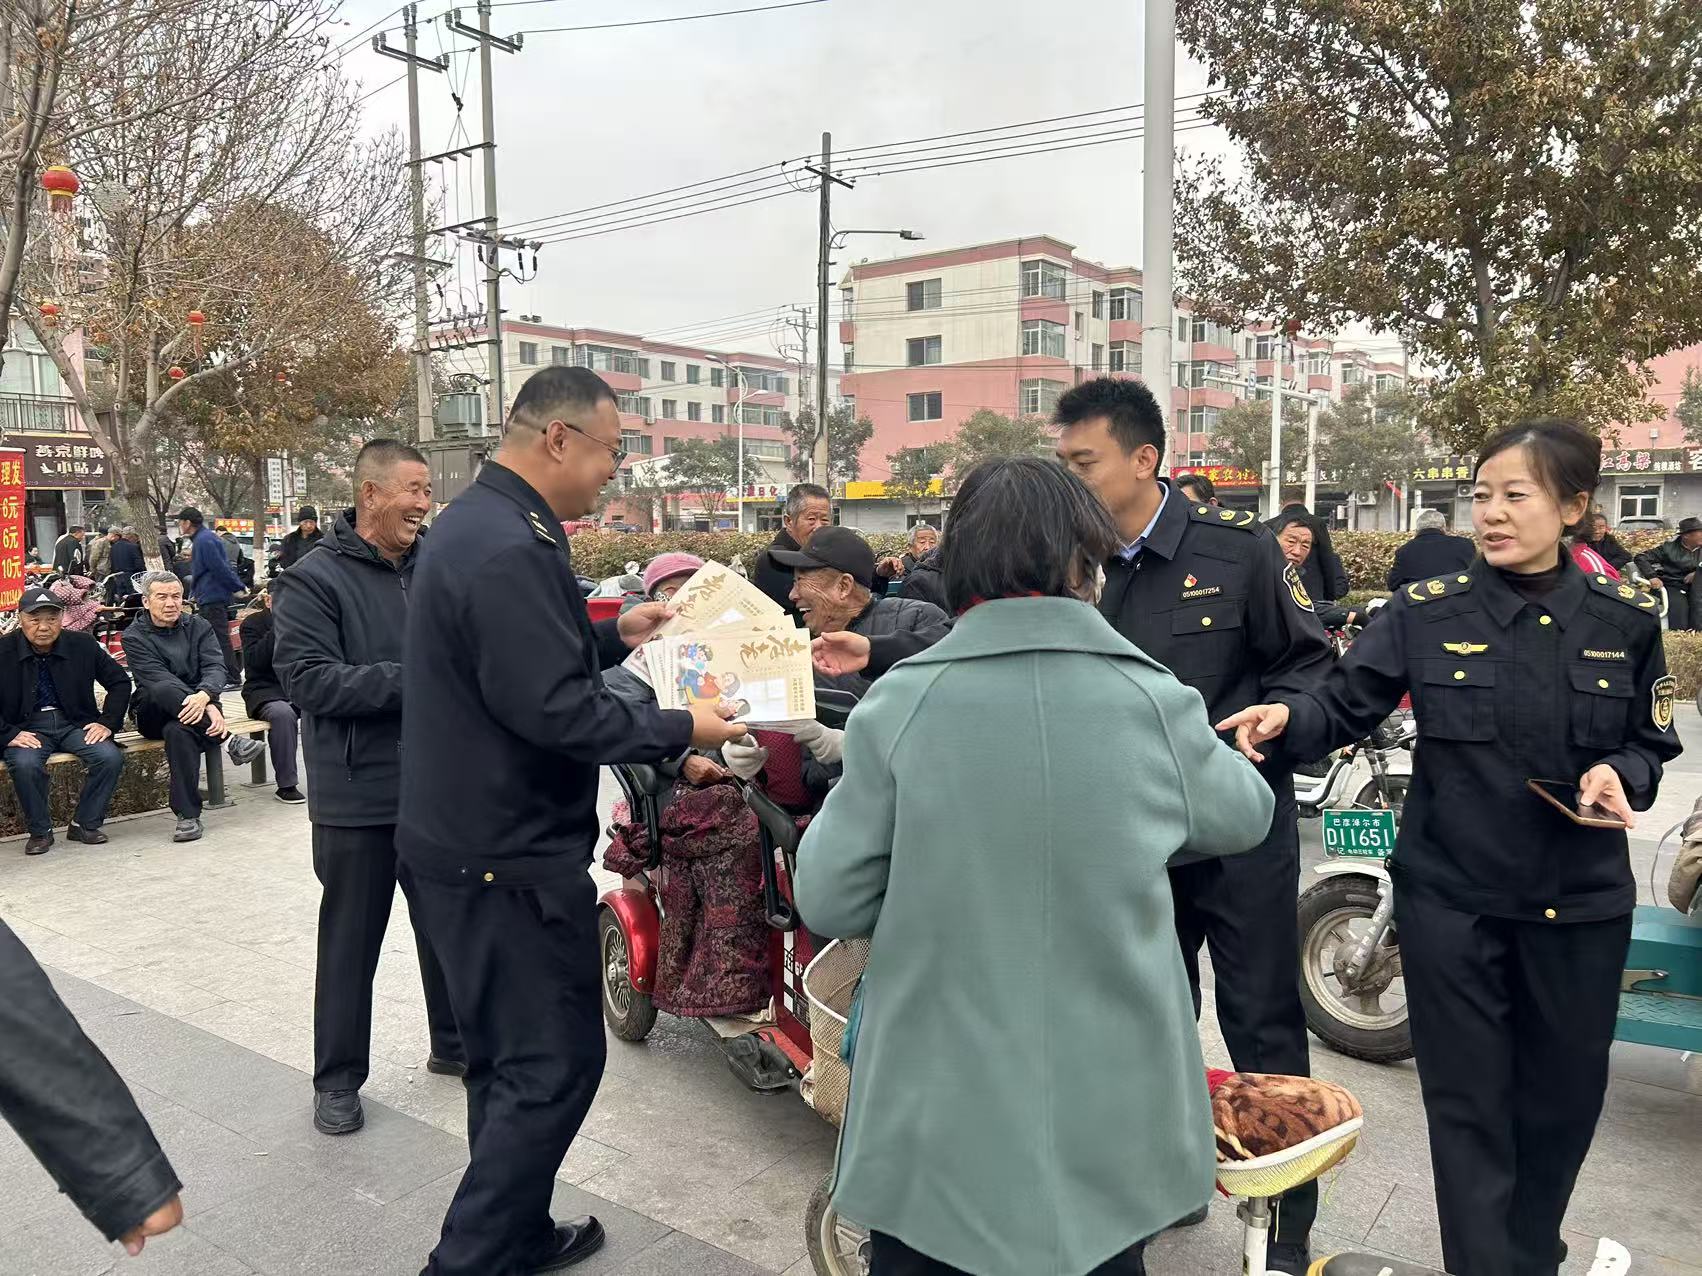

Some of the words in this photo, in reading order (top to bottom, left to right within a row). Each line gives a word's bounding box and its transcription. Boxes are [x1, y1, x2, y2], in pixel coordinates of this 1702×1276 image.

[57, 461, 89, 475] 小站
[1413, 467, 1469, 480] 六串串香
[3, 526, 18, 549] 6元
[2, 556, 21, 579] 10元
[1183, 587, 1220, 598] 05100017254
[1583, 649, 1625, 658] 05100017144
[1333, 818, 1380, 827] 巴彦淖尔市
[1326, 828, 1389, 846] D11651
